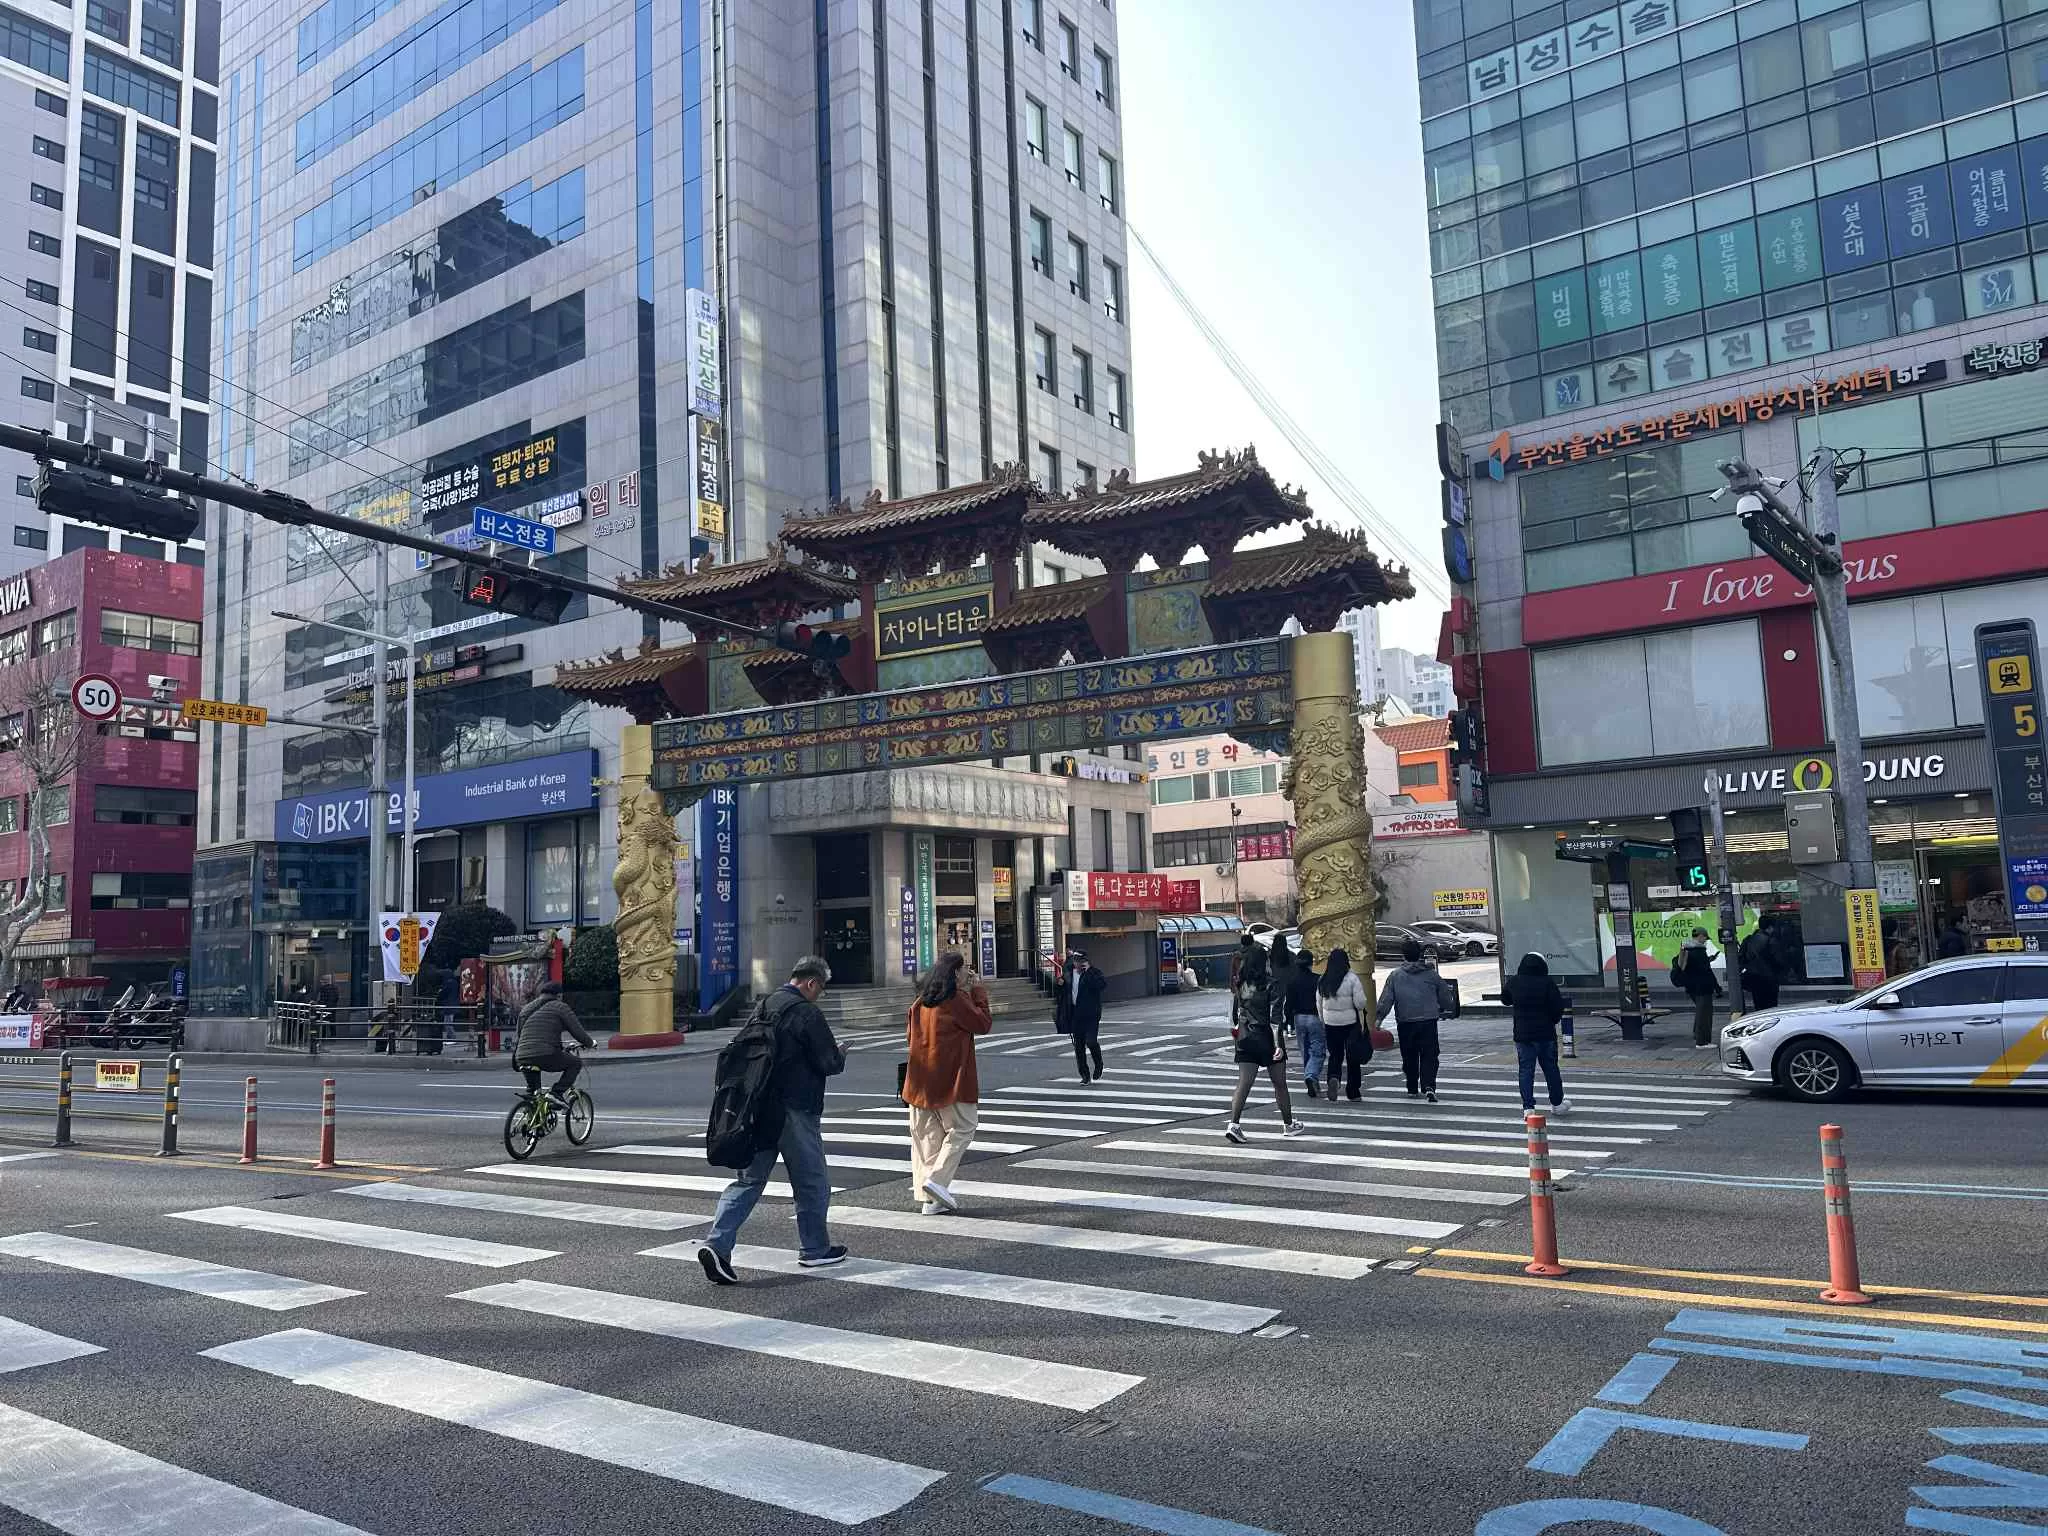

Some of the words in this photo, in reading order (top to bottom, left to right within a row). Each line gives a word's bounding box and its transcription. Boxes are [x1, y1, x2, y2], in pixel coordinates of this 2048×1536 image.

[1475, 2, 1670, 92] 남성수술
[1906, 184, 1930, 239] 코골이
[1969, 168, 1989, 227] 어지럼증
[1841, 201, 1865, 257] 설소대
[1552, 286, 1571, 328] 비염
[697, 321, 718, 391] 더보상
[1517, 364, 1893, 469] 부산울산도박문제예방치유센터
[1897, 363, 1928, 384] 5F
[453, 470, 462, 487] 등
[463, 464, 480, 483] 수술
[496, 468, 521, 489] 무료
[524, 457, 551, 480] 상담
[480, 514, 549, 548] 버스전용
[703, 517, 719, 531] PT
[1661, 579, 1684, 612] I
[1702, 567, 1774, 606] love
[884, 605, 987, 644] 차이나타운
[85, 687, 110, 708] 50
[190, 703, 206, 716] 신호
[210, 705, 225, 718] 과속
[228, 706, 242, 720] 단속
[246, 708, 261, 723] 장비
[2013, 704, 2037, 738] 5
[465, 778, 504, 797] Industrial
[505, 776, 527, 792] Bank
[528, 775, 539, 788] of
[540, 773, 567, 787] Korea
[1862, 754, 1945, 783] OUNG
[2024, 755, 2044, 806] 부산역
[541, 789, 567, 806] 부산역
[712, 788, 736, 806] IBK
[716, 810, 731, 903] 기업은행
[1689, 866, 1707, 886] 15
[1649, 929, 1689, 939] YOUNG
[1651, 919, 1669, 929] WE
[1670, 919, 1694, 928] ARE
